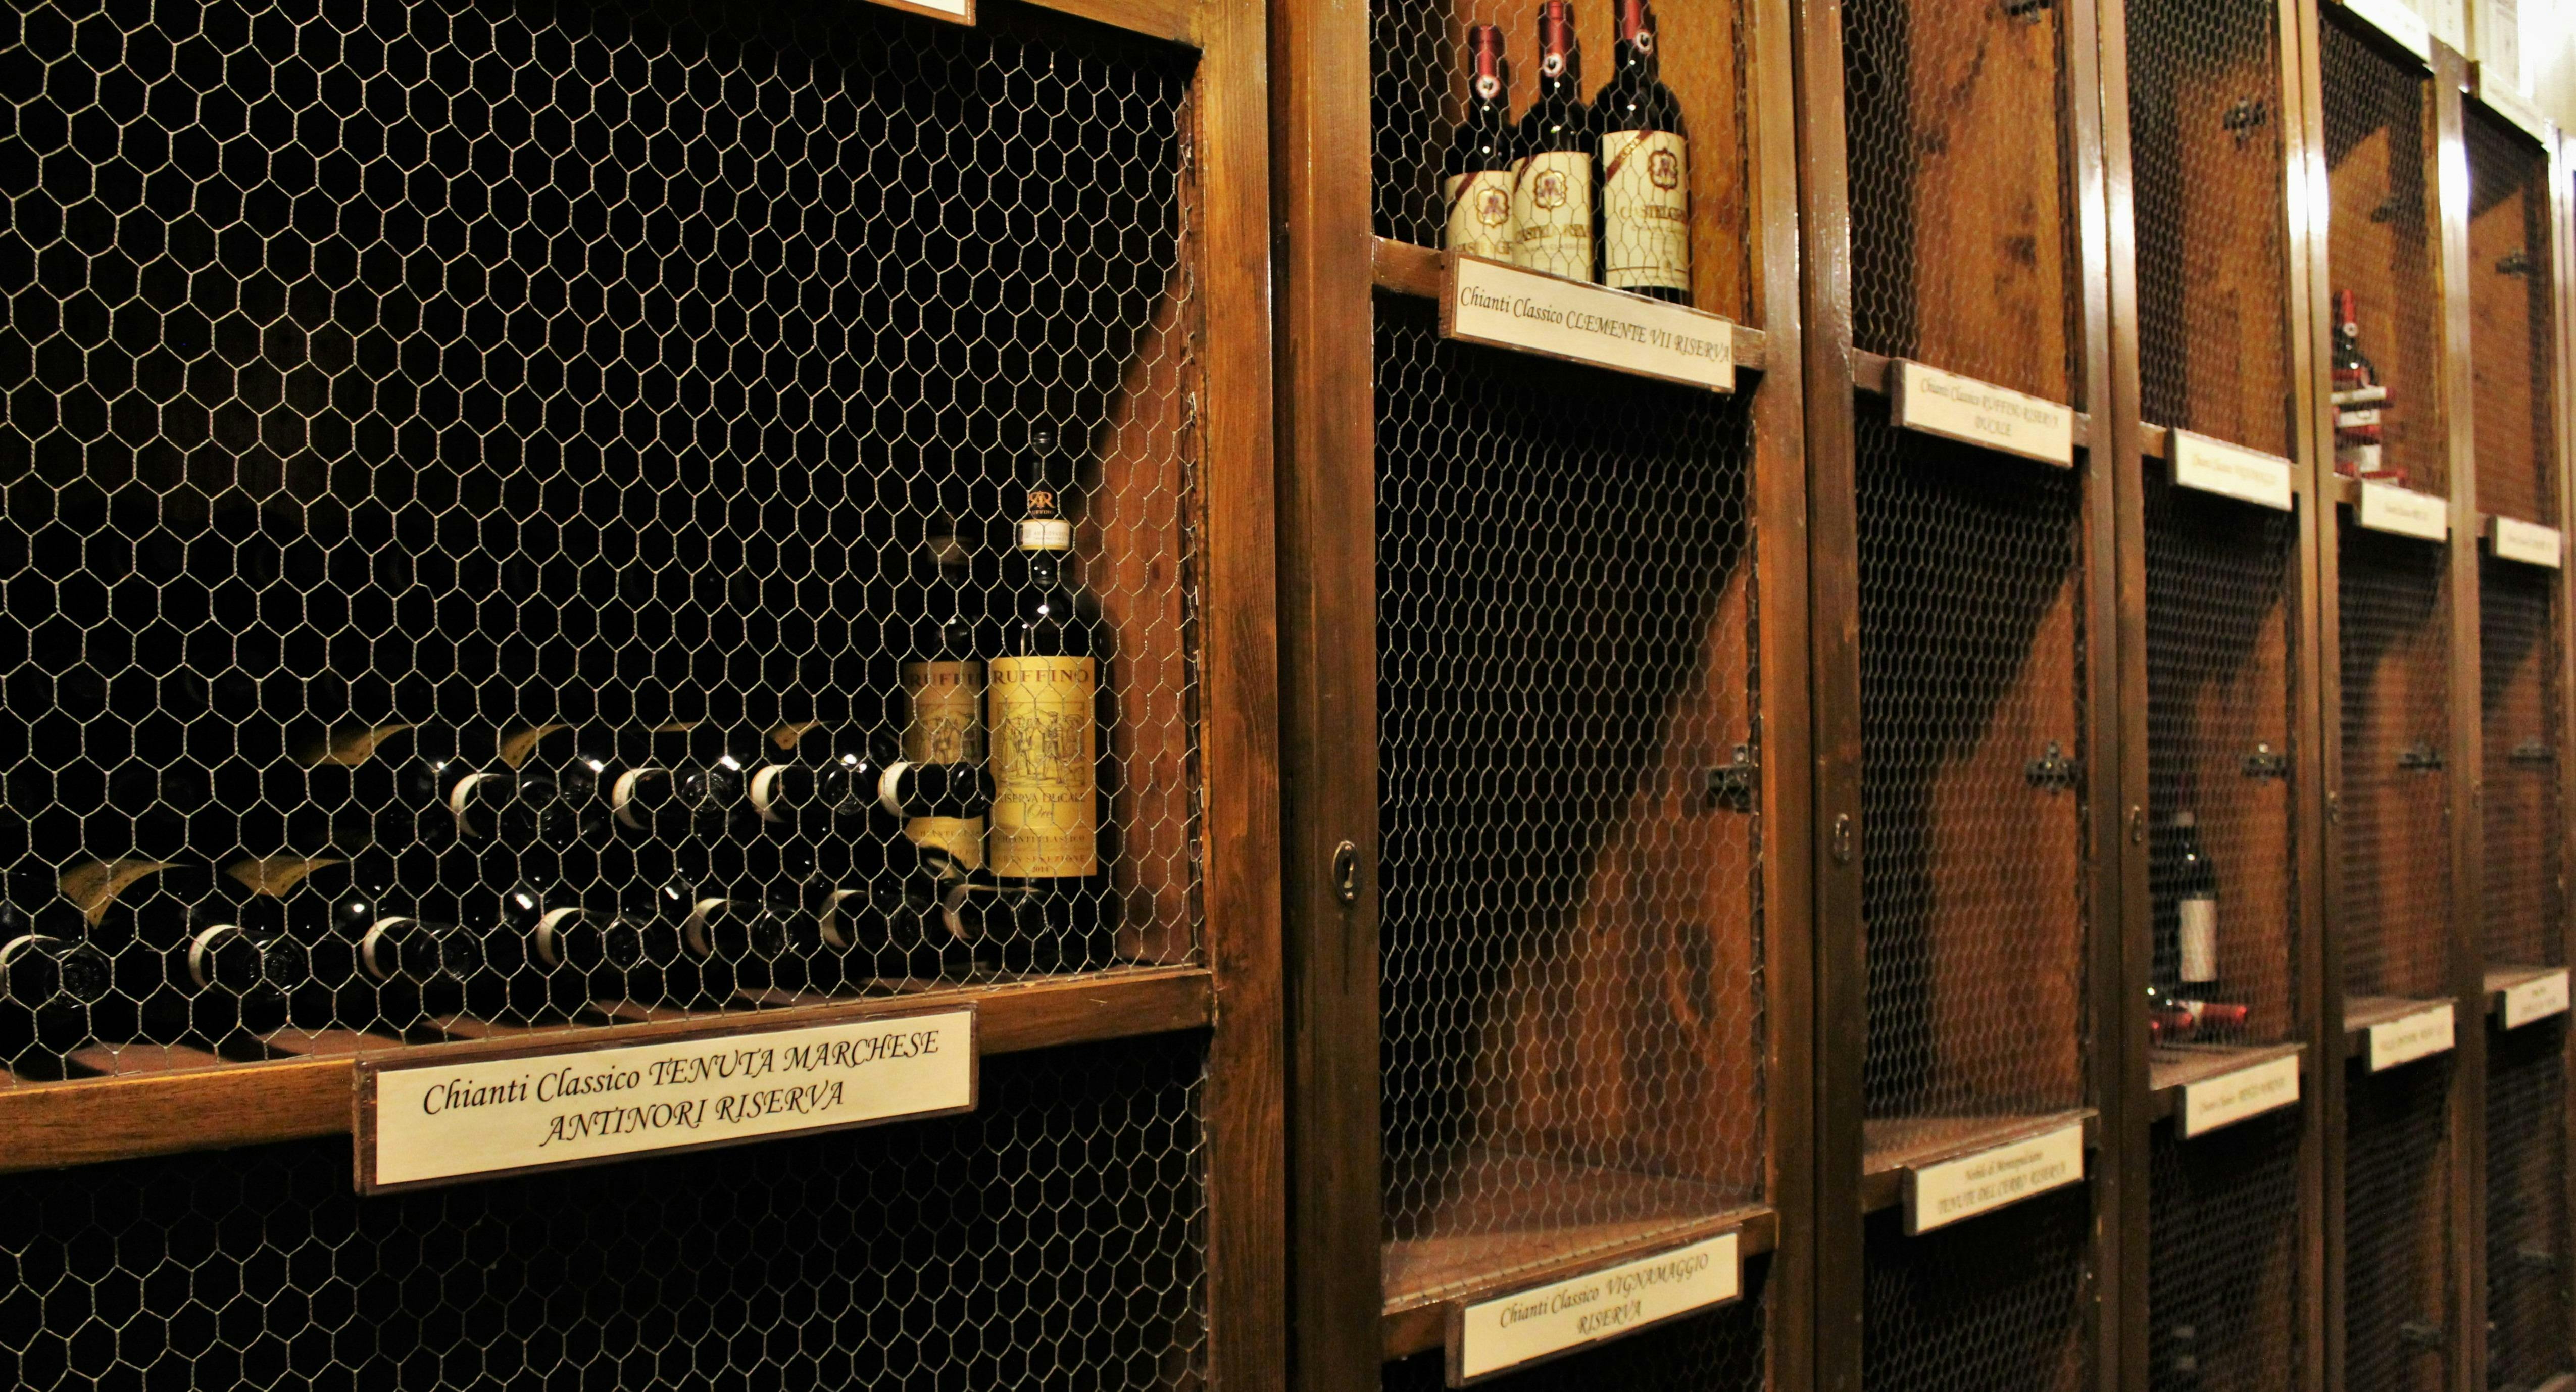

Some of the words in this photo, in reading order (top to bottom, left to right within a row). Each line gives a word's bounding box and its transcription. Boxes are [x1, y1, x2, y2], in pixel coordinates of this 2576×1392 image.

[1460, 286, 1511, 313] Chianti
[1513, 298, 1563, 324] Classico
[1566, 310, 1646, 344] CLEMENTE
[1650, 329, 1671, 349] VII
[1674, 335, 1731, 363] RISERVA
[993, 668, 1089, 684] RUFFINO
[423, 1073, 529, 1115] Chianti
[536, 1065, 640, 1103] Classico
[648, 1048, 774, 1086] TENUTA
[782, 1030, 939, 1071] MARCHESE
[538, 1099, 709, 1147] ANTINORI
[714, 1080, 844, 1123] RISERVA
[1500, 1302, 1548, 1328] Chianti
[1551, 1288, 1600, 1314] Classico
[1605, 1253, 1709, 1298] VIGNAMAGGIO
[1577, 1300, 1642, 1335] RISERVA
